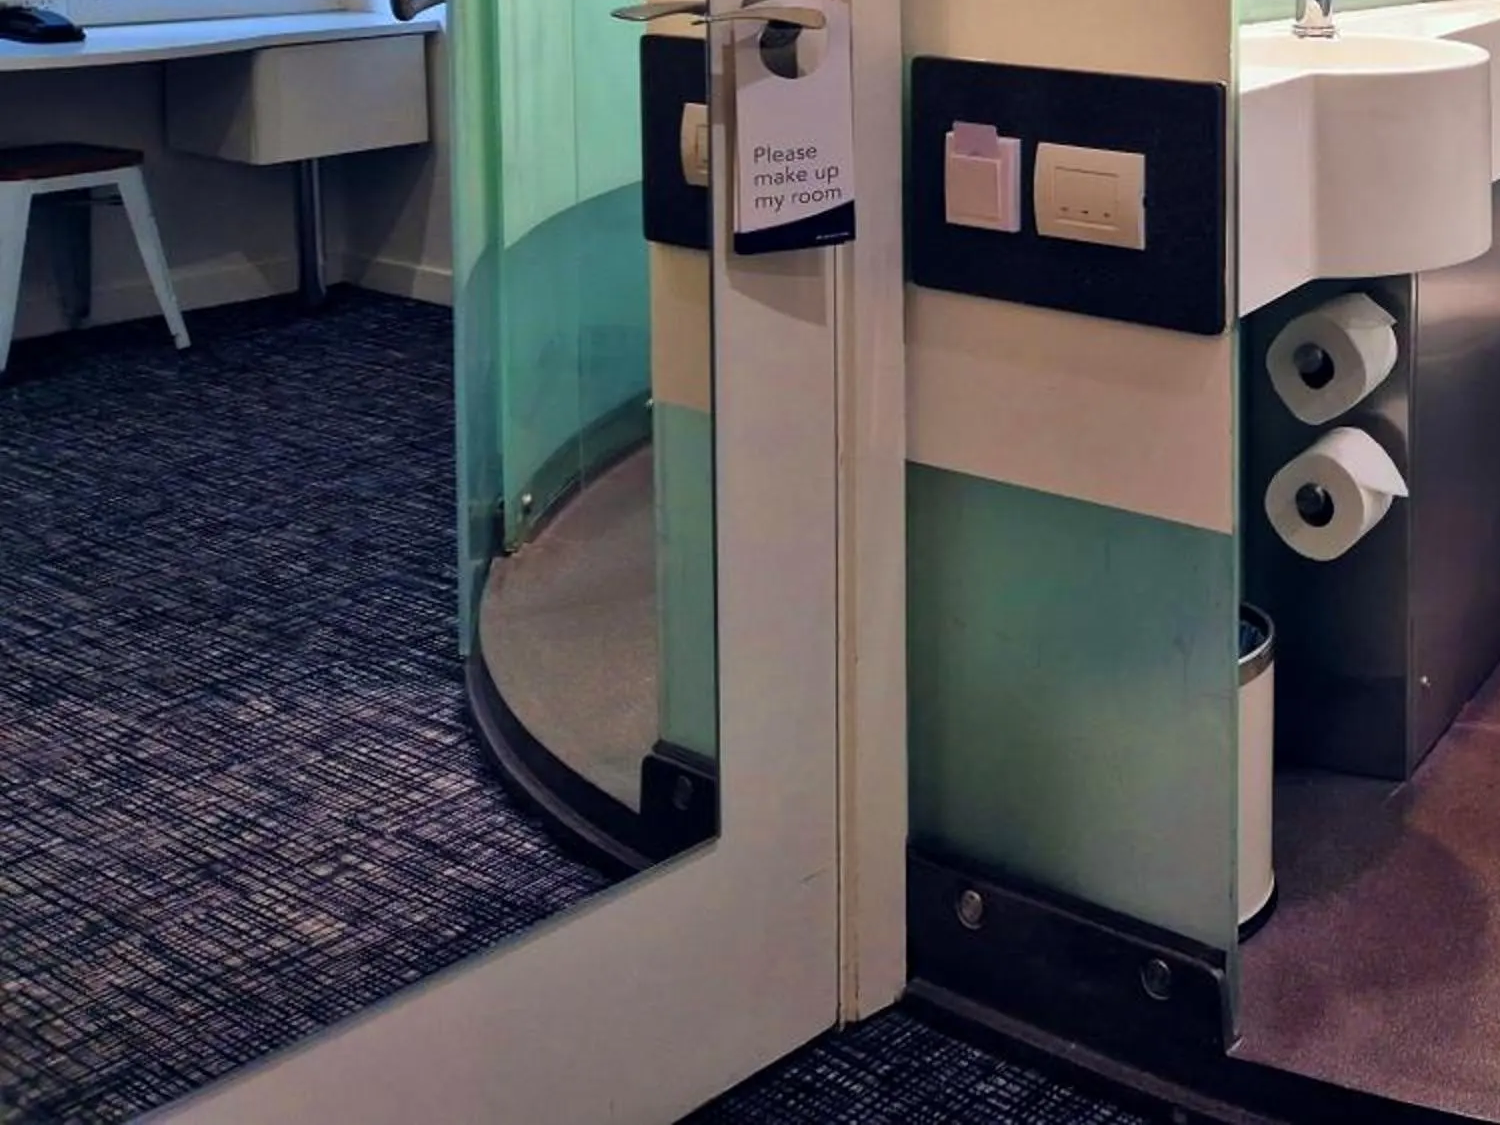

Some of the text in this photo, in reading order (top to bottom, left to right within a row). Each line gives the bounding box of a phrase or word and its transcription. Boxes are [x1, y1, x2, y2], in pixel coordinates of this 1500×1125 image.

[754, 145, 817, 163] Please
[754, 165, 839, 186] make up
[755, 187, 842, 212] my room
